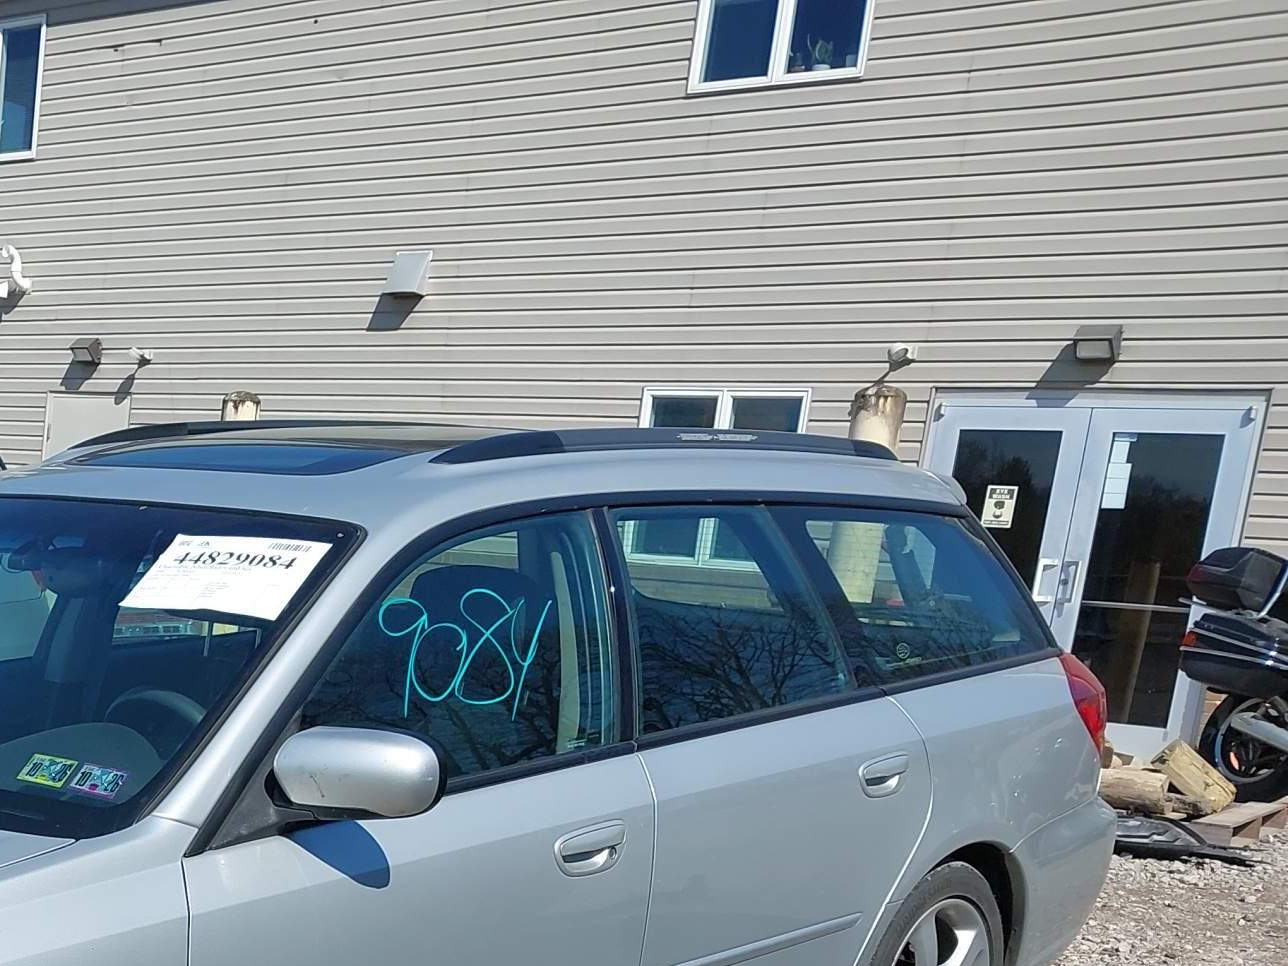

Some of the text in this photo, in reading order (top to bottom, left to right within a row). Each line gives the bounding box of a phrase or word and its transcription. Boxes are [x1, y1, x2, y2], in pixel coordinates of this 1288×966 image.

[173, 551, 297, 570] 44829084
[378, 588, 553, 722] 9084
[75, 770, 93, 787] 10
